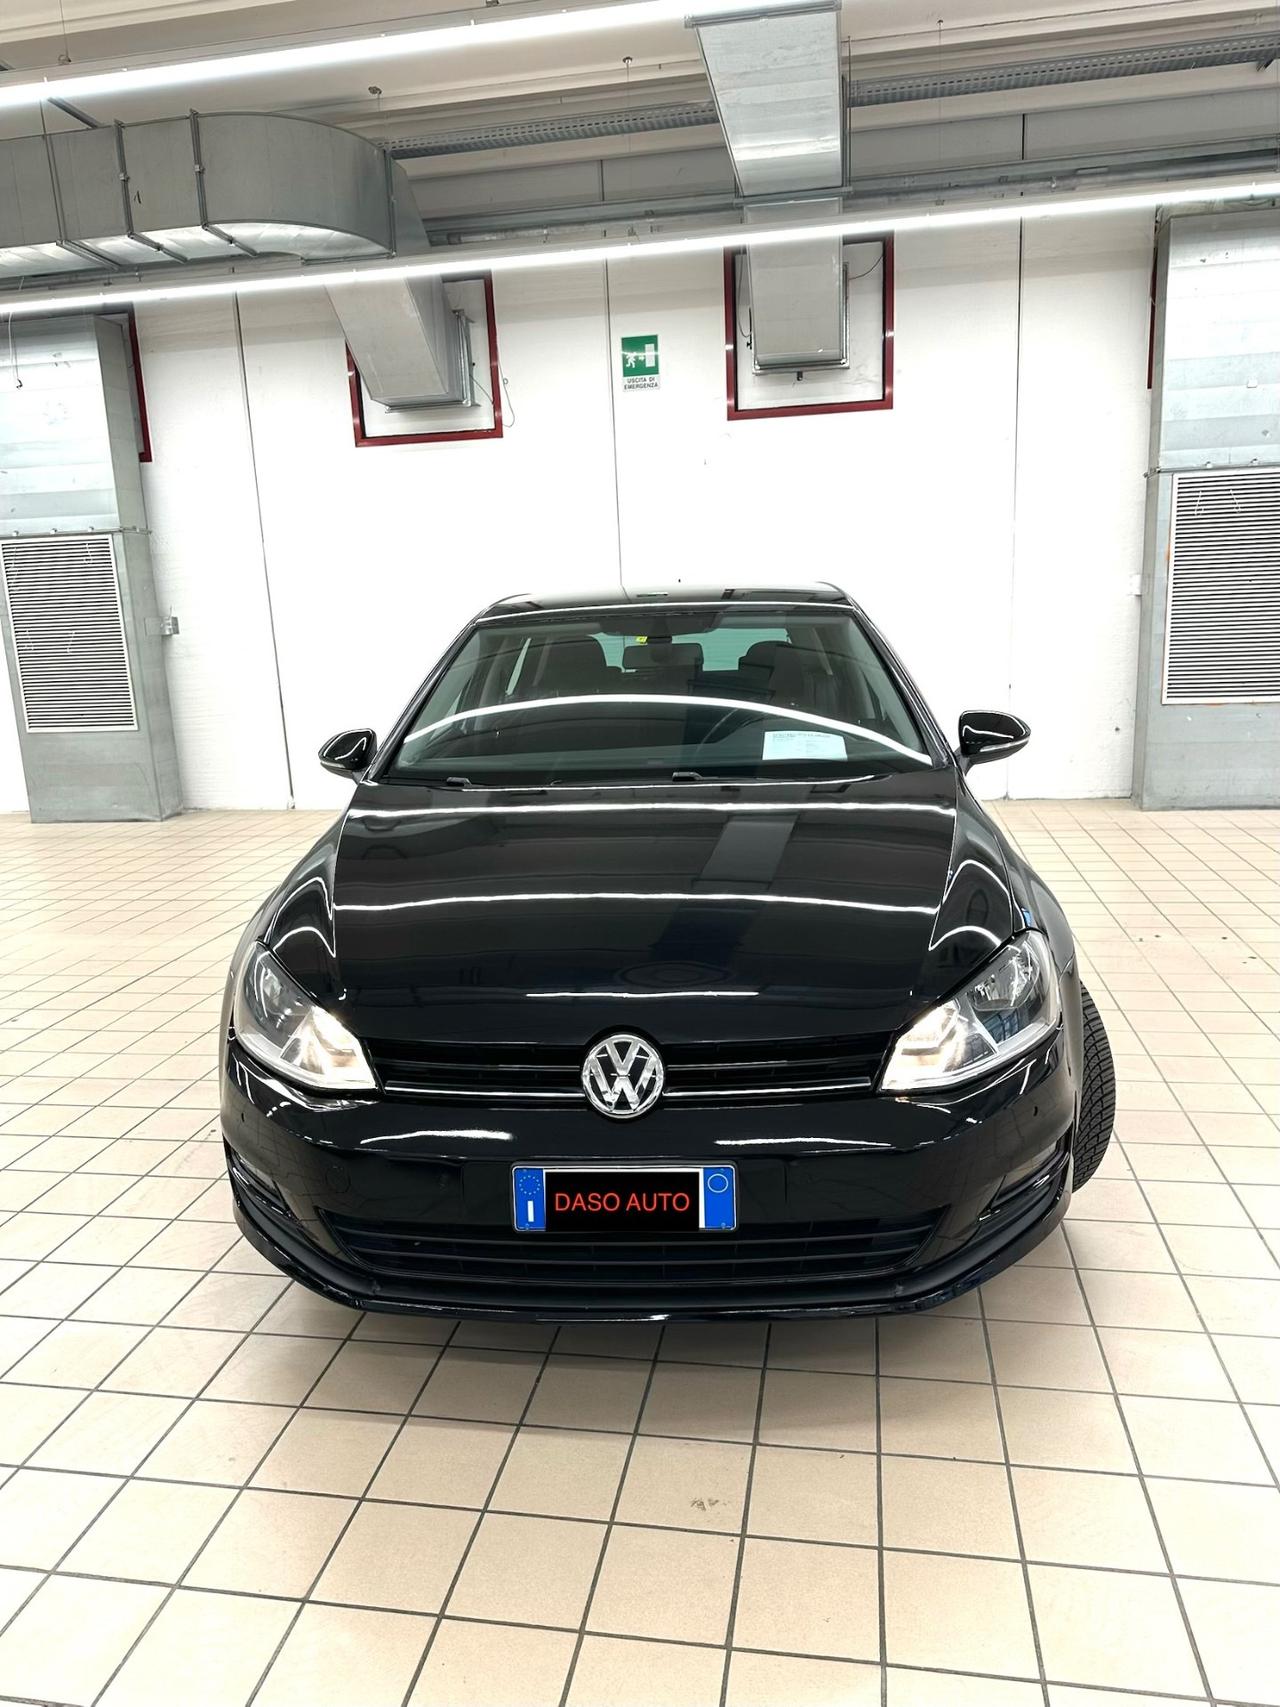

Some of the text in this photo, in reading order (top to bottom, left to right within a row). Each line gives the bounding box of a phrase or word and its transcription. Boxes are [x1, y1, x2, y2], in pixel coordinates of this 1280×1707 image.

[624, 382, 659, 390] EMERGENZA
[584, 1036, 661, 1116] VW
[527, 1200, 534, 1222] I
